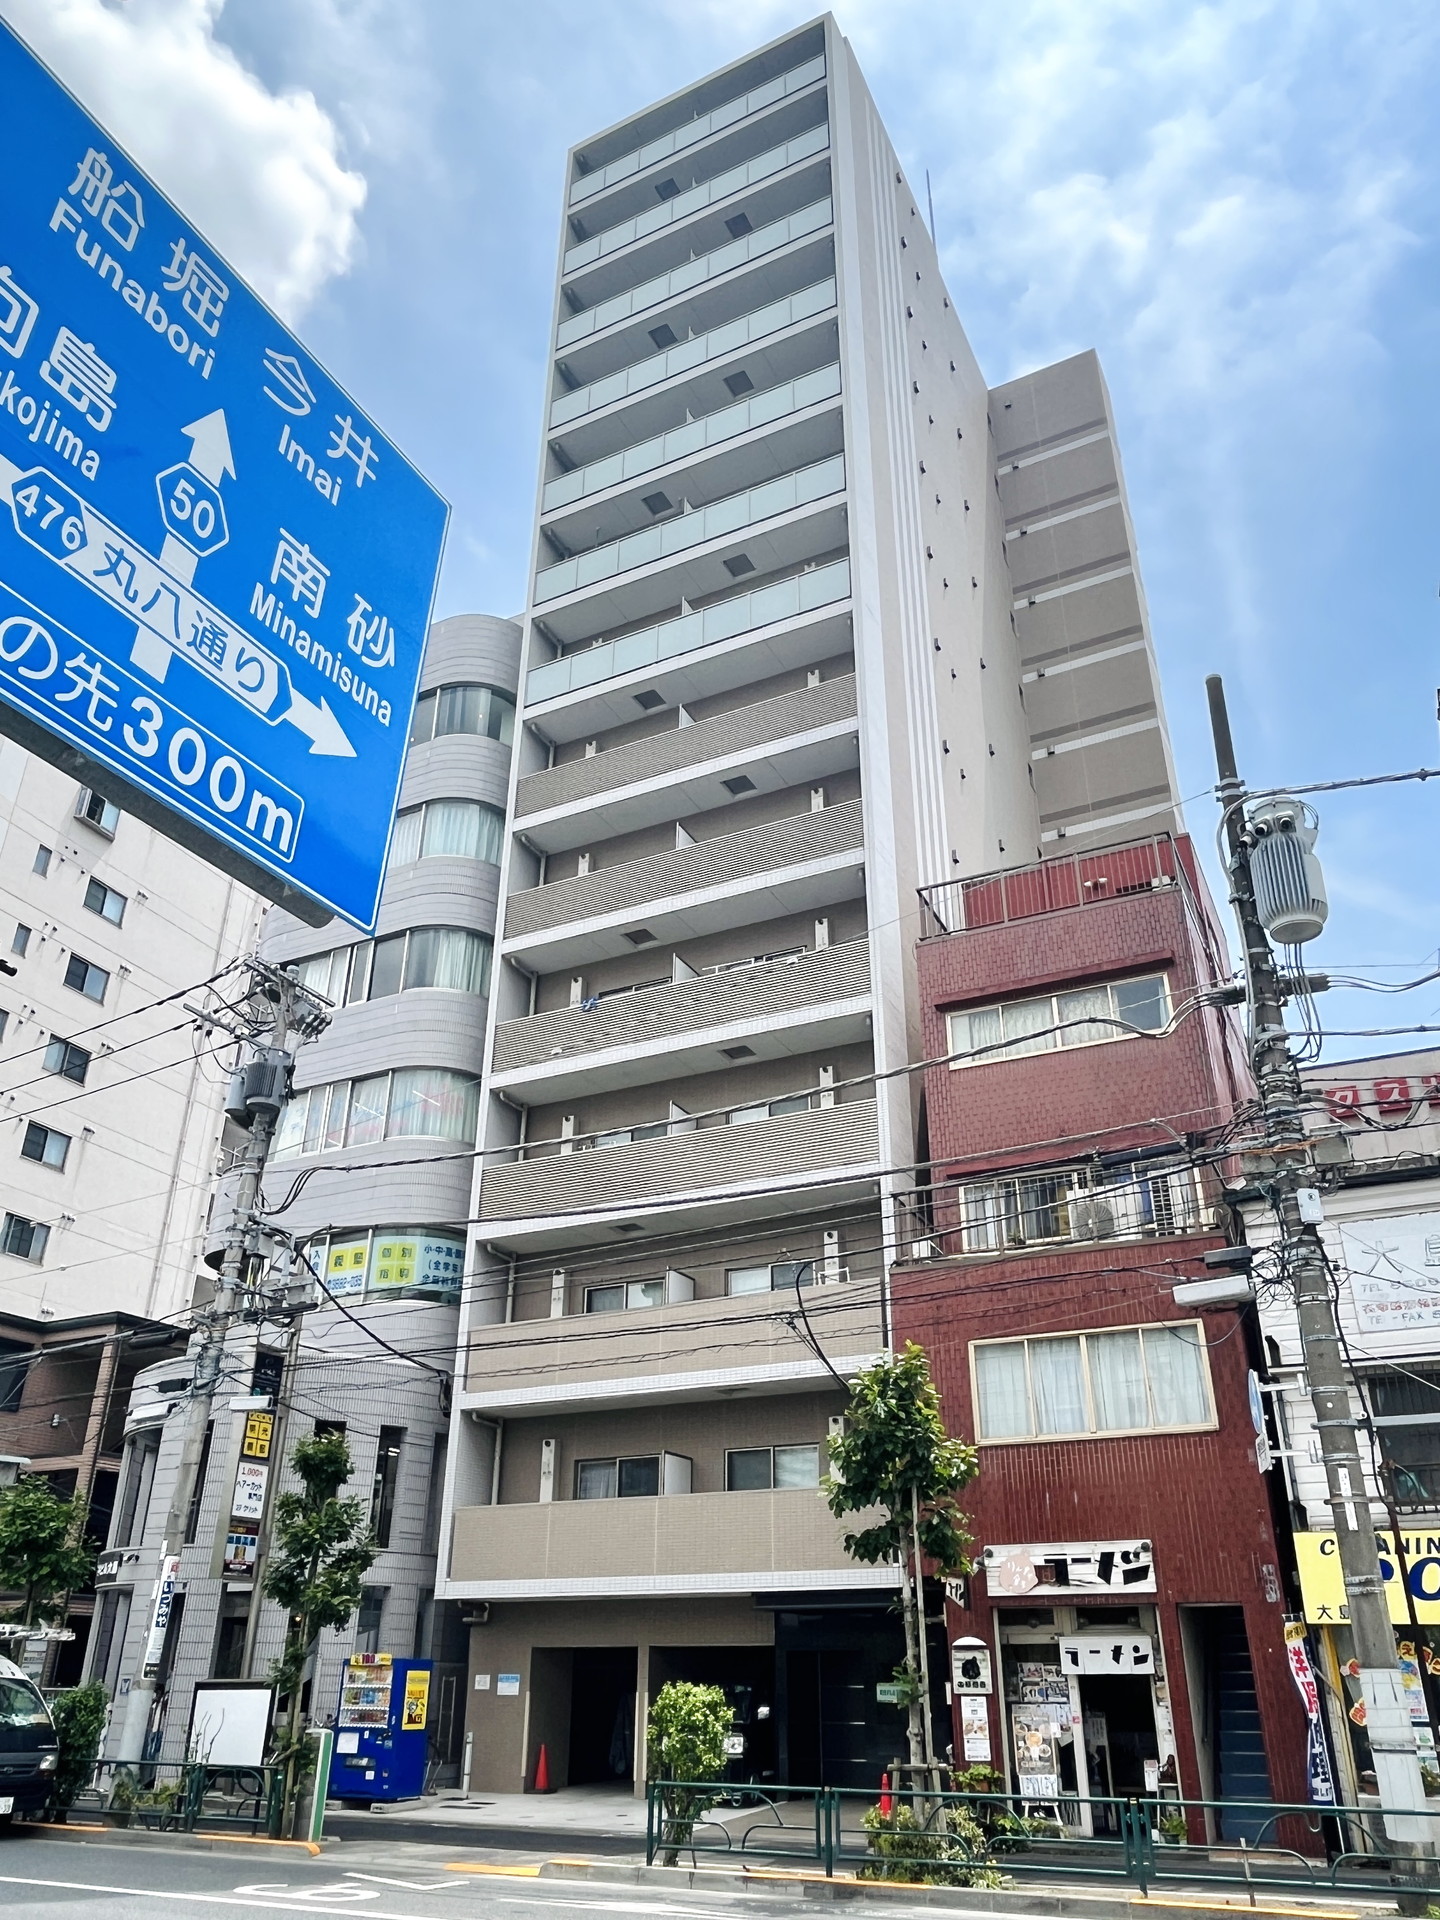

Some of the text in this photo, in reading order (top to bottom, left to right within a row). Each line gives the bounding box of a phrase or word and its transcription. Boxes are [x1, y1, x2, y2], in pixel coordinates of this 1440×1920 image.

[49, 197, 217, 381] Funabori
[68, 147, 229, 337] 船堀
[0, 369, 101, 481] kojima
[262, 346, 380, 487] 今井
[278, 424, 343, 506] Imai
[15, 483, 84, 552] 476
[169, 480, 216, 539] 50
[94, 545, 268, 692] 丸八通り
[249, 581, 393, 729] Minamisuna
[270, 527, 396, 668] 南砂
[1064, 1645, 1150, 1668] ラーメン
